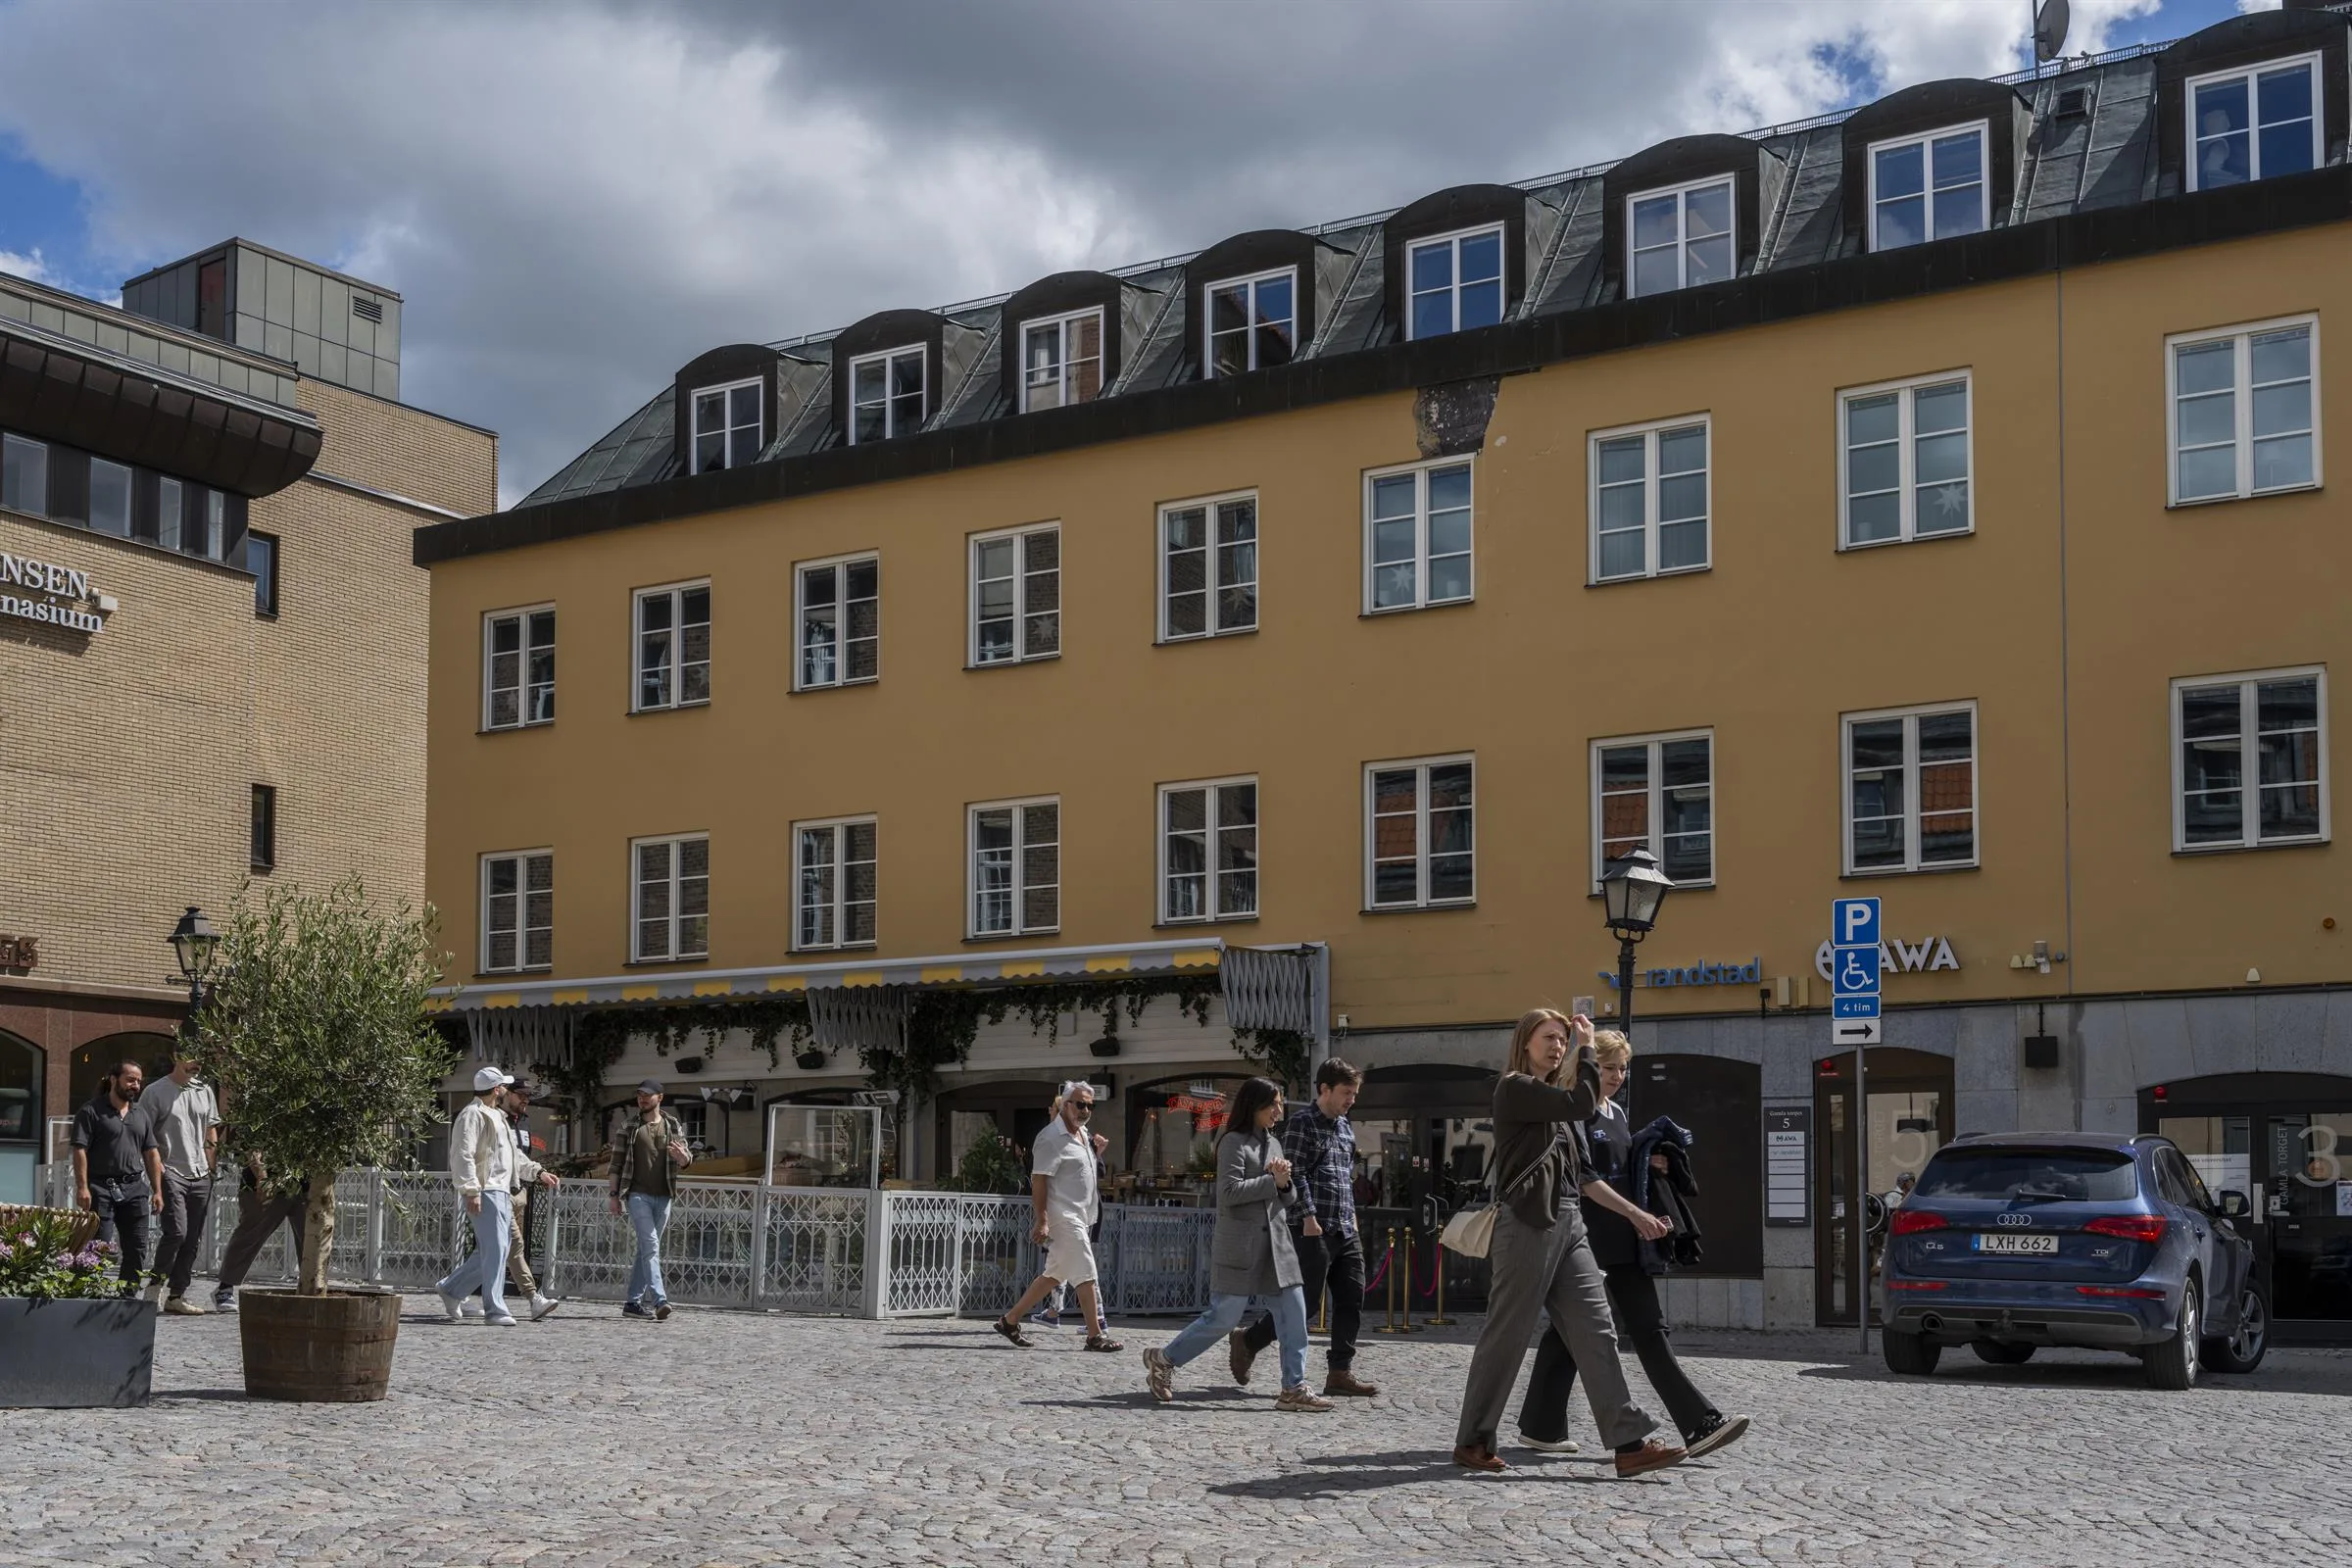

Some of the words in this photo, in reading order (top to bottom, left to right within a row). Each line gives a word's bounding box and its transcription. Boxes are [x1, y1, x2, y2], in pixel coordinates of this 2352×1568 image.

[0, 553, 90, 600] NSEN
[0, 594, 104, 634] nasium
[1845, 903, 1872, 942] P
[1646, 956, 1762, 989] randstad
[1843, 1003, 1850, 1012] 4
[1853, 1002, 1871, 1012] tim
[1782, 1118, 1790, 1129] 5
[1889, 1108, 1927, 1168] 5
[2277, 1125, 2289, 1165] TORGET
[2295, 1124, 2341, 1188] 3
[2278, 1168, 2289, 1205] GAMLA
[1926, 1241, 1944, 1250] Q5
[1985, 1235, 2015, 1250] LXH
[2020, 1236, 2051, 1250] 662
